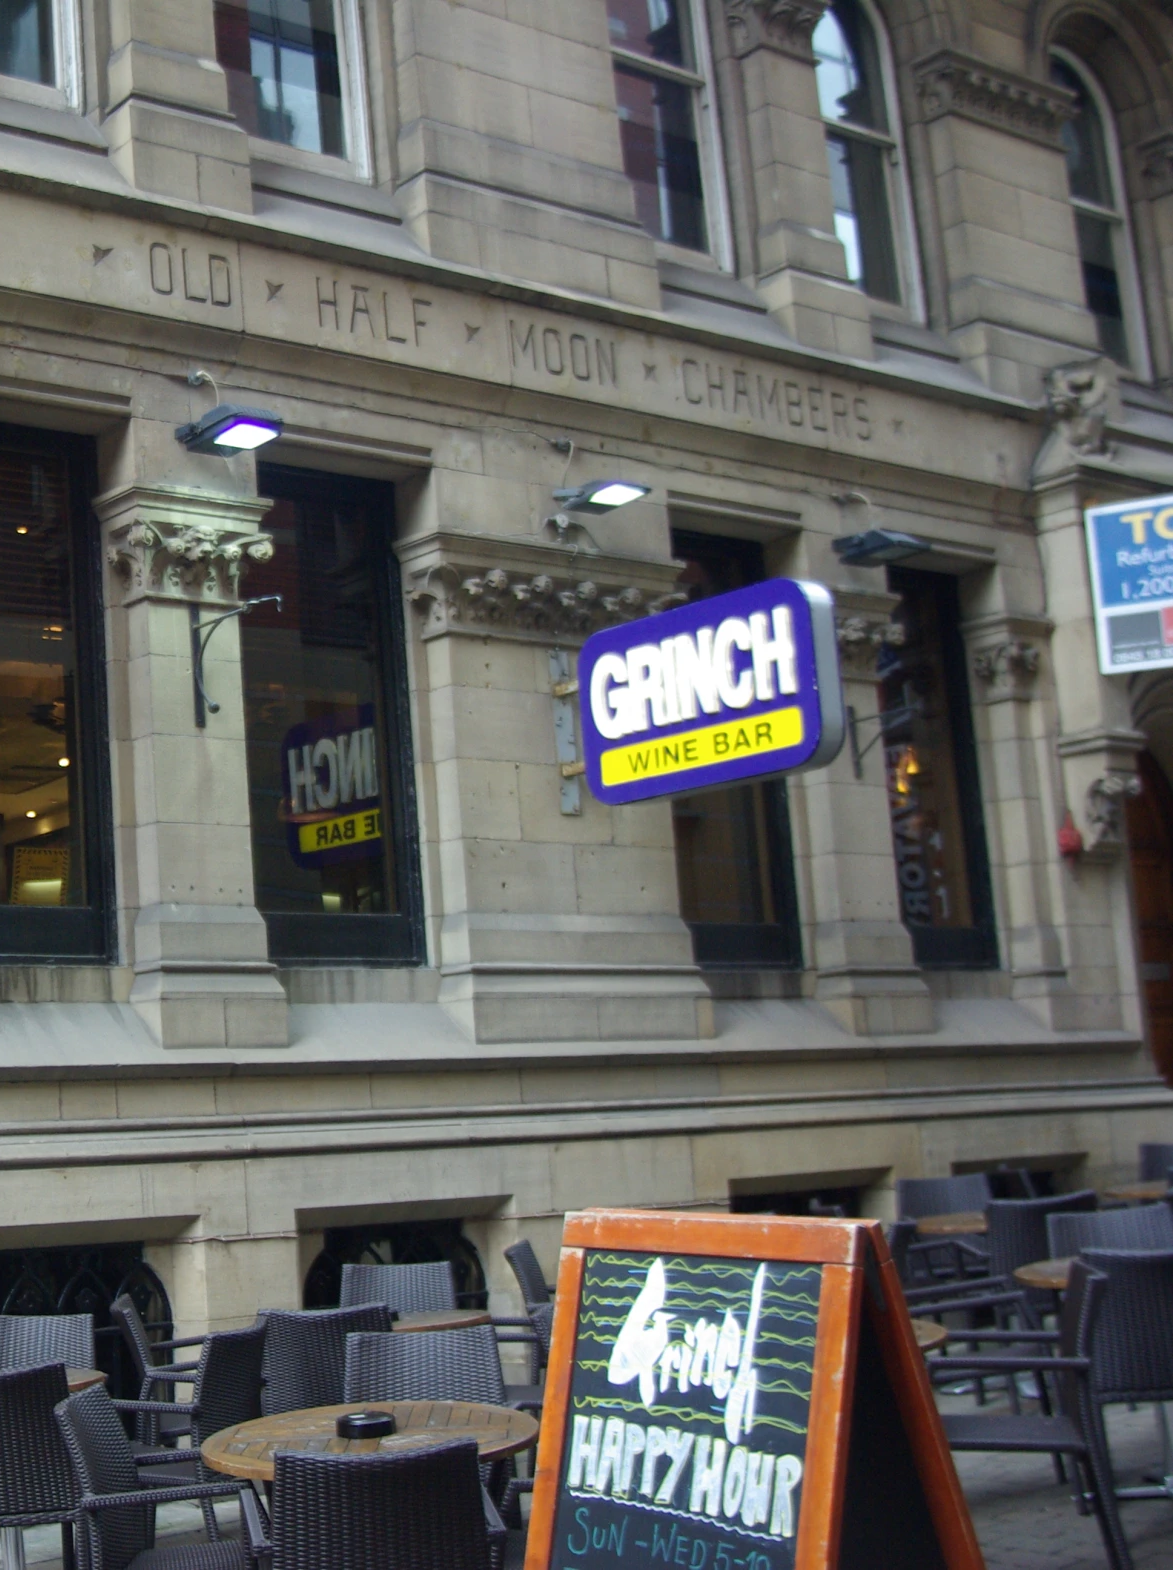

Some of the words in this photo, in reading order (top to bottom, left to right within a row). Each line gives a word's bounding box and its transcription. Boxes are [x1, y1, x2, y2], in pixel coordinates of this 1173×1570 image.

[149, 242, 231, 307] OLD
[316, 276, 432, 347] HALF
[509, 319, 619, 388] MOON
[681, 359, 872, 441] CHAMBERS
[590, 604, 798, 739] GRINCH
[628, 738, 699, 774] WINE
[713, 722, 773, 756] BAR
[567, 1414, 694, 1504] HAPPY
[688, 1434, 803, 1538] HOUR
